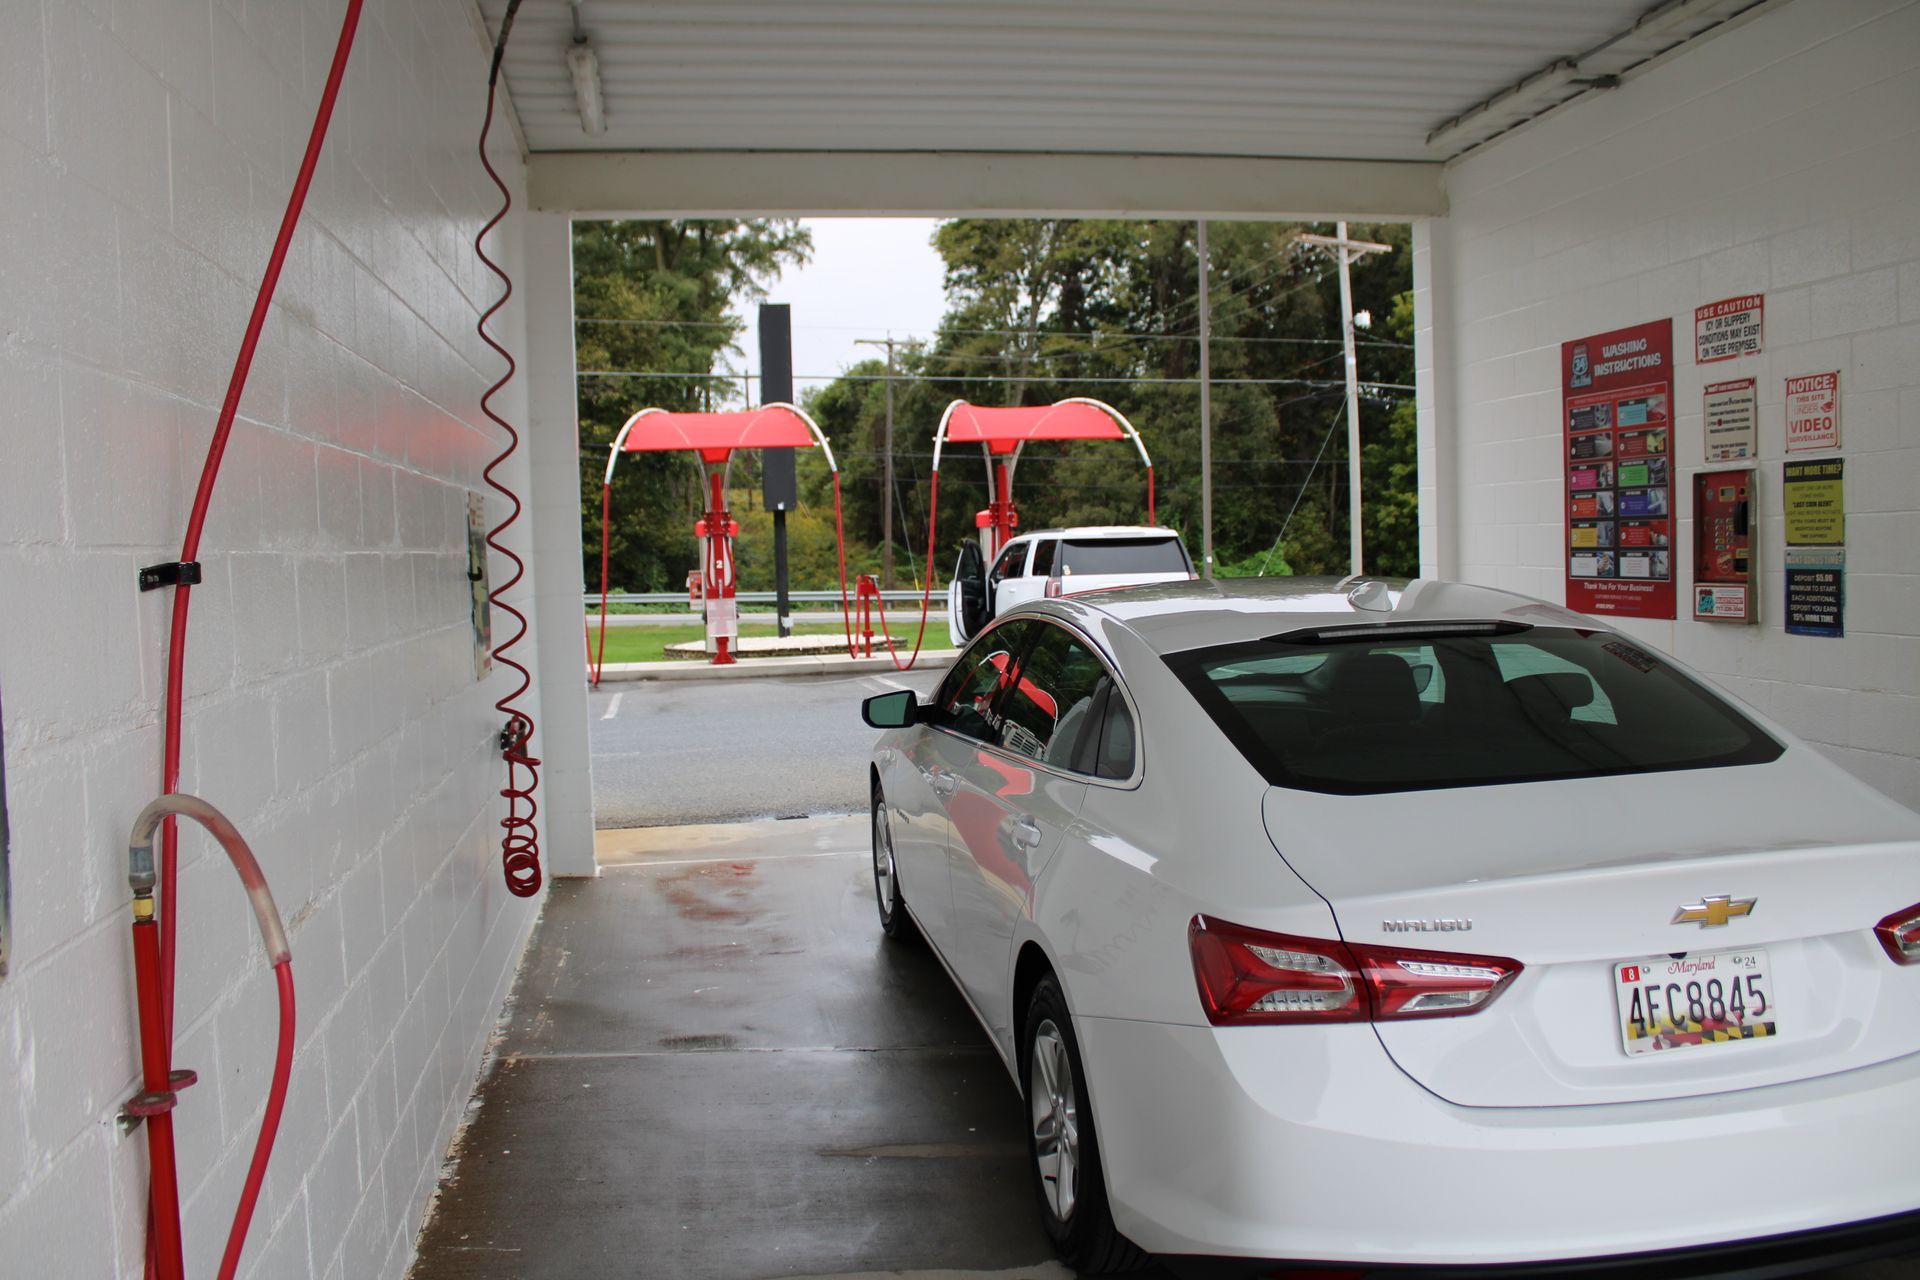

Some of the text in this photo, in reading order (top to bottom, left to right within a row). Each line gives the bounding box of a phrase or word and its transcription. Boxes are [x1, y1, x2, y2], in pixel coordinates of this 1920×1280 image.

[1697, 297, 1760, 319] USE CAUTION
[1705, 312, 1751, 331] ICY OR SLIPPERY
[1698, 323, 1760, 346] CONDITIONS MAY EXIST
[1602, 338, 1647, 358] WASHING
[1701, 347, 1710, 358] ON
[1710, 343, 1727, 356] THESE
[1593, 352, 1662, 377] INSTRUCTIONS
[1789, 375, 1834, 394] NOTICE:
[1811, 393, 1825, 401] SITE
[1793, 402, 1818, 414] UNDER
[1790, 416, 1832, 433] VIDEO
[1789, 432, 1835, 443] SURVEILLANCE
[1786, 466, 1803, 477] WANT
[716, 560, 723, 569] 2
[1815, 574, 1833, 582] $5.00
[1584, 582, 1597, 590] Thank
[1608, 583, 1616, 591] For
[1617, 583, 1629, 591] Your
[1629, 584, 1654, 592] Business!
[1804, 614, 1820, 622] MORE
[1382, 918, 1472, 932] MALIBU
[1628, 956, 1756, 981] 8 Maryland 24
[1630, 974, 1766, 1031] 4FC8845
